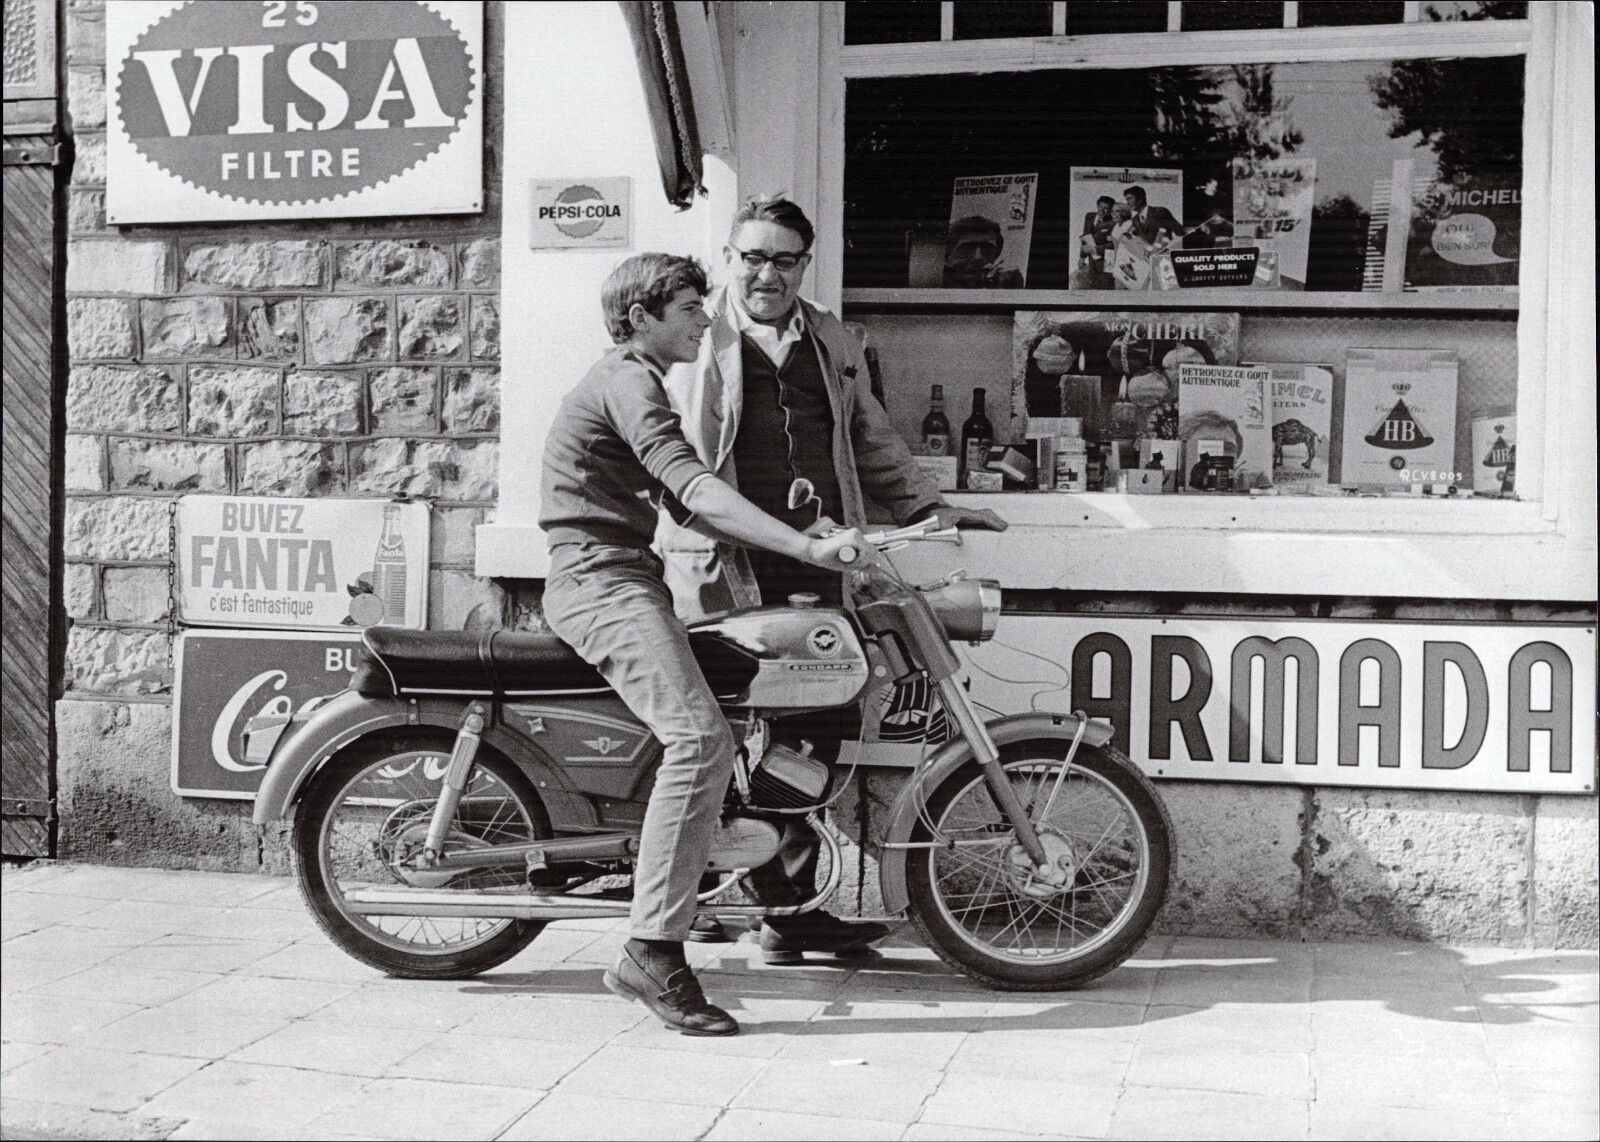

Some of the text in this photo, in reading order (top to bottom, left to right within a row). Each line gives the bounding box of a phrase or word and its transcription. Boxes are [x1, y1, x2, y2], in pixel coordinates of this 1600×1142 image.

[262, 1, 318, 28] 25
[132, 37, 457, 138] VISA
[220, 148, 361, 181] FILTRE
[1444, 189, 1522, 206] MICHEL
[1174, 253, 1256, 264] QUALITY PRODUCTS
[1193, 263, 1238, 272] SOLD HERE
[1131, 322, 1206, 340] CHERI
[1181, 367, 1234, 379] RETROUVEZ
[1234, 370, 1246, 379] CE
[1181, 377, 1242, 388] AUTHENTIQUE
[1383, 419, 1416, 442] HB
[222, 502, 305, 534] BUVEZ
[190, 535, 338, 593] FANTA
[209, 592, 314, 617] c'est fantastique
[1070, 630, 1574, 774] ARMADA
